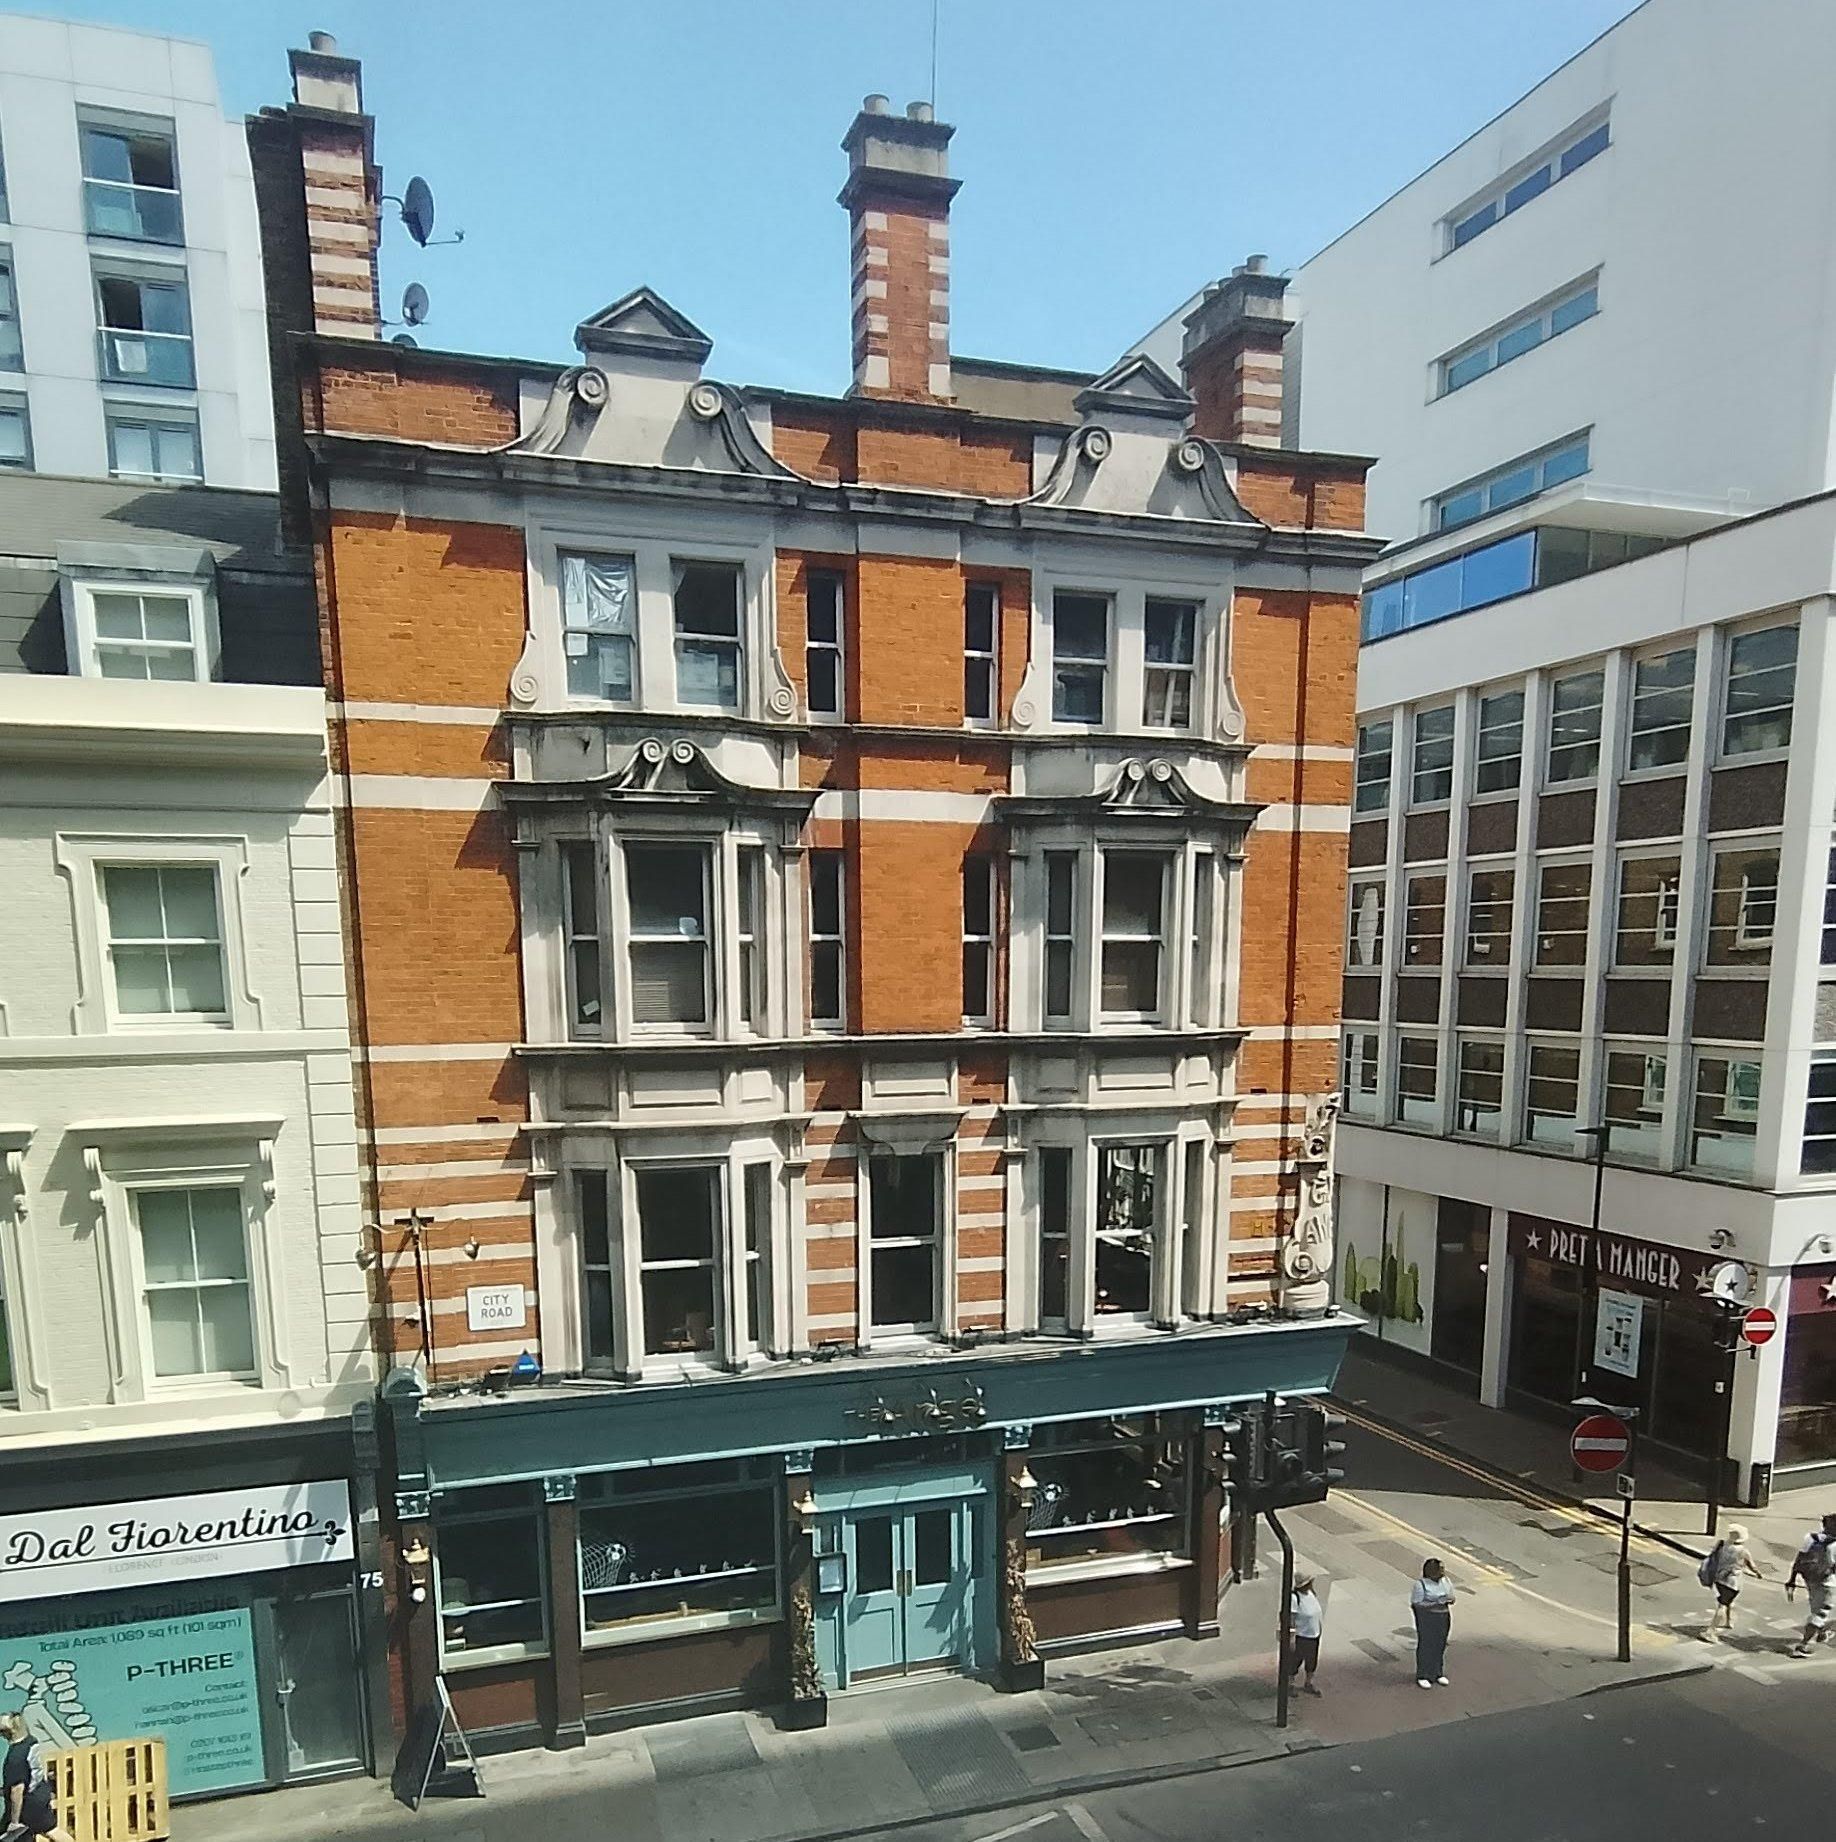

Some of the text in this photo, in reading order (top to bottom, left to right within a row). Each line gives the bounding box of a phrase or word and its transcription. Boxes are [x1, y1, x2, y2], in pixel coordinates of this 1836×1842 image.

[1550, 1228, 1588, 1266] PRET
[1609, 1242, 1680, 1291] MANGER
[483, 1294, 509, 1306] CITY
[481, 1306, 513, 1318] ROAD
[5, 1507, 319, 1565] Dal Fiorentino
[360, 1571, 384, 1589] 75
[38, 1640, 69, 1653] Total
[148, 1629, 165, 1639] sq
[167, 1625, 180, 1636] ft
